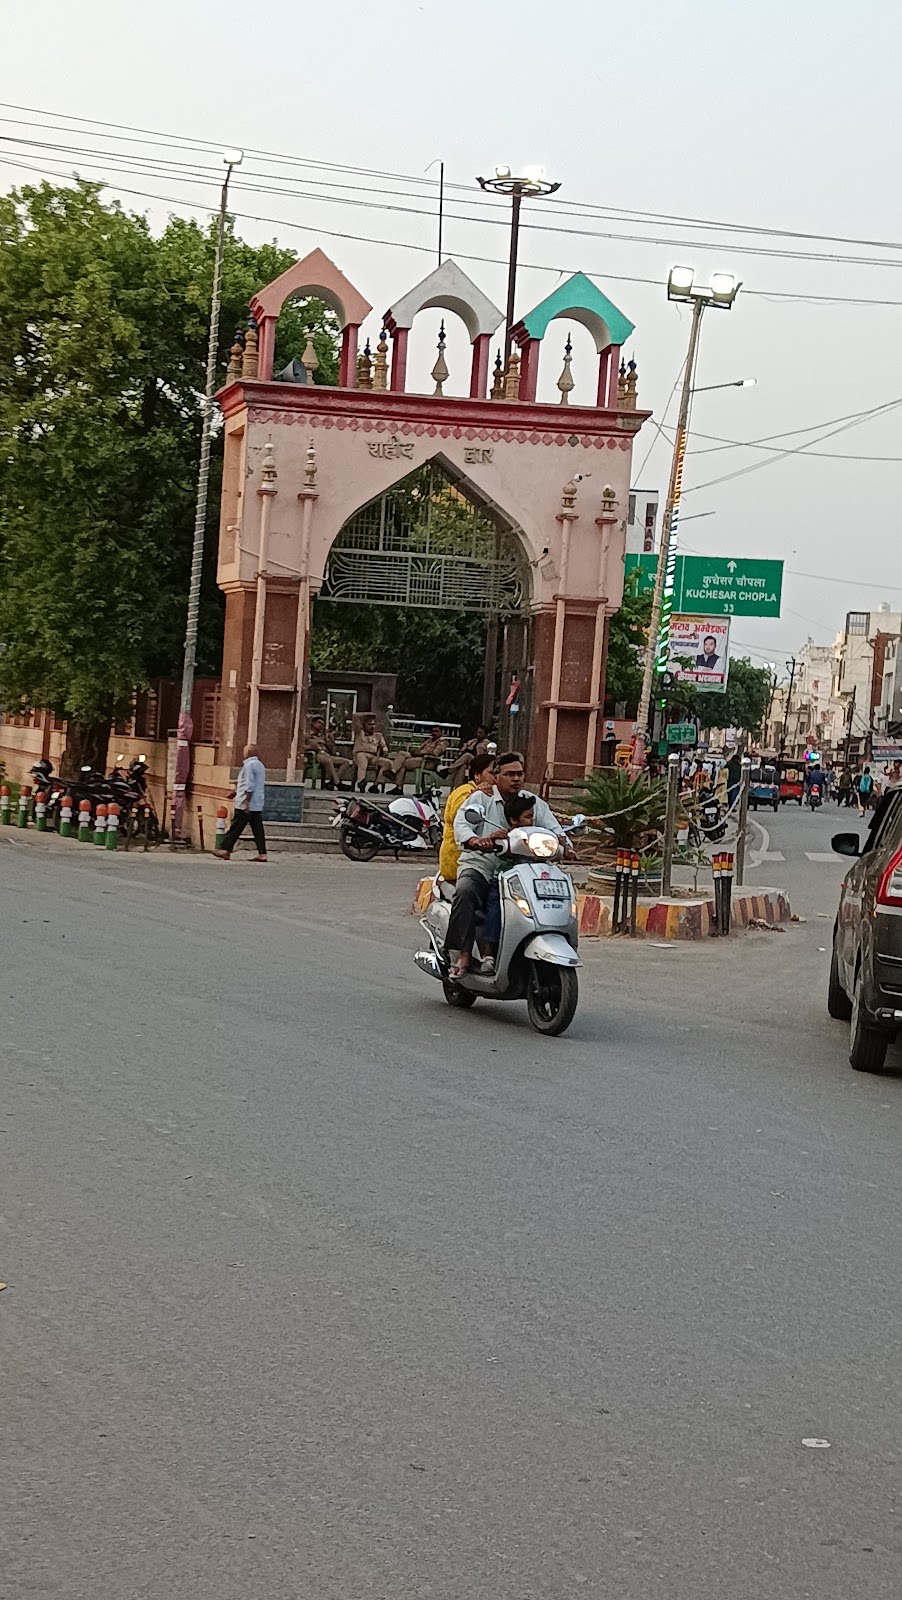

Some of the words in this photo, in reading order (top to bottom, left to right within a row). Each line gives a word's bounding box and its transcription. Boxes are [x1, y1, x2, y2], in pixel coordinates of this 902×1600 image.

[702, 573, 734, 588] कुचेसर
[686, 588, 737, 600] KUCHESAR
[738, 591, 777, 602] CHOPLA
[723, 603, 735, 613] 33
